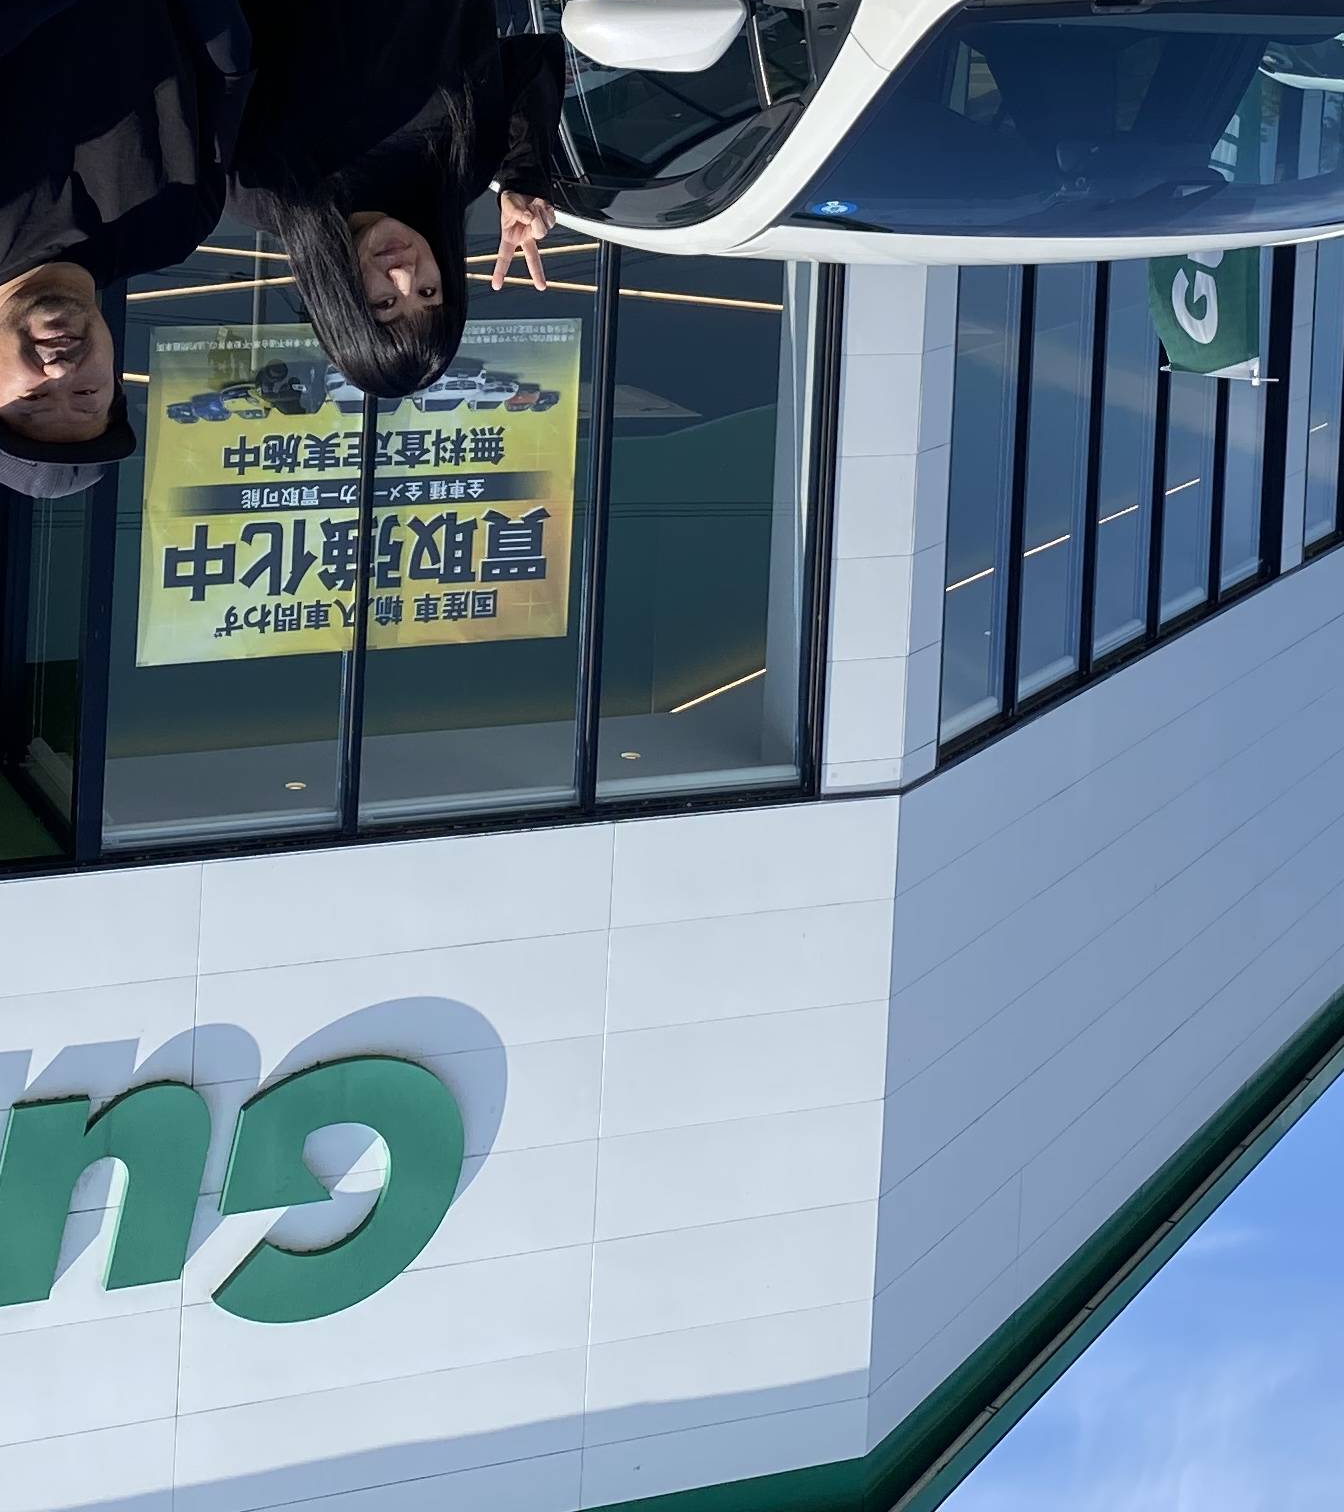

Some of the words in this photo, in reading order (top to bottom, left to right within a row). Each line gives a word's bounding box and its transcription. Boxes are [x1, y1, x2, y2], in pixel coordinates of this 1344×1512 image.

[223, 426, 506, 476] 無料査定実施中
[241, 481, 423, 509] 全メーカー買取可能
[429, 477, 485, 501] 全車種
[162, 506, 551, 602] 買取強化中
[213, 593, 404, 639] 輸入車問わず
[413, 589, 498, 624] 国産車
